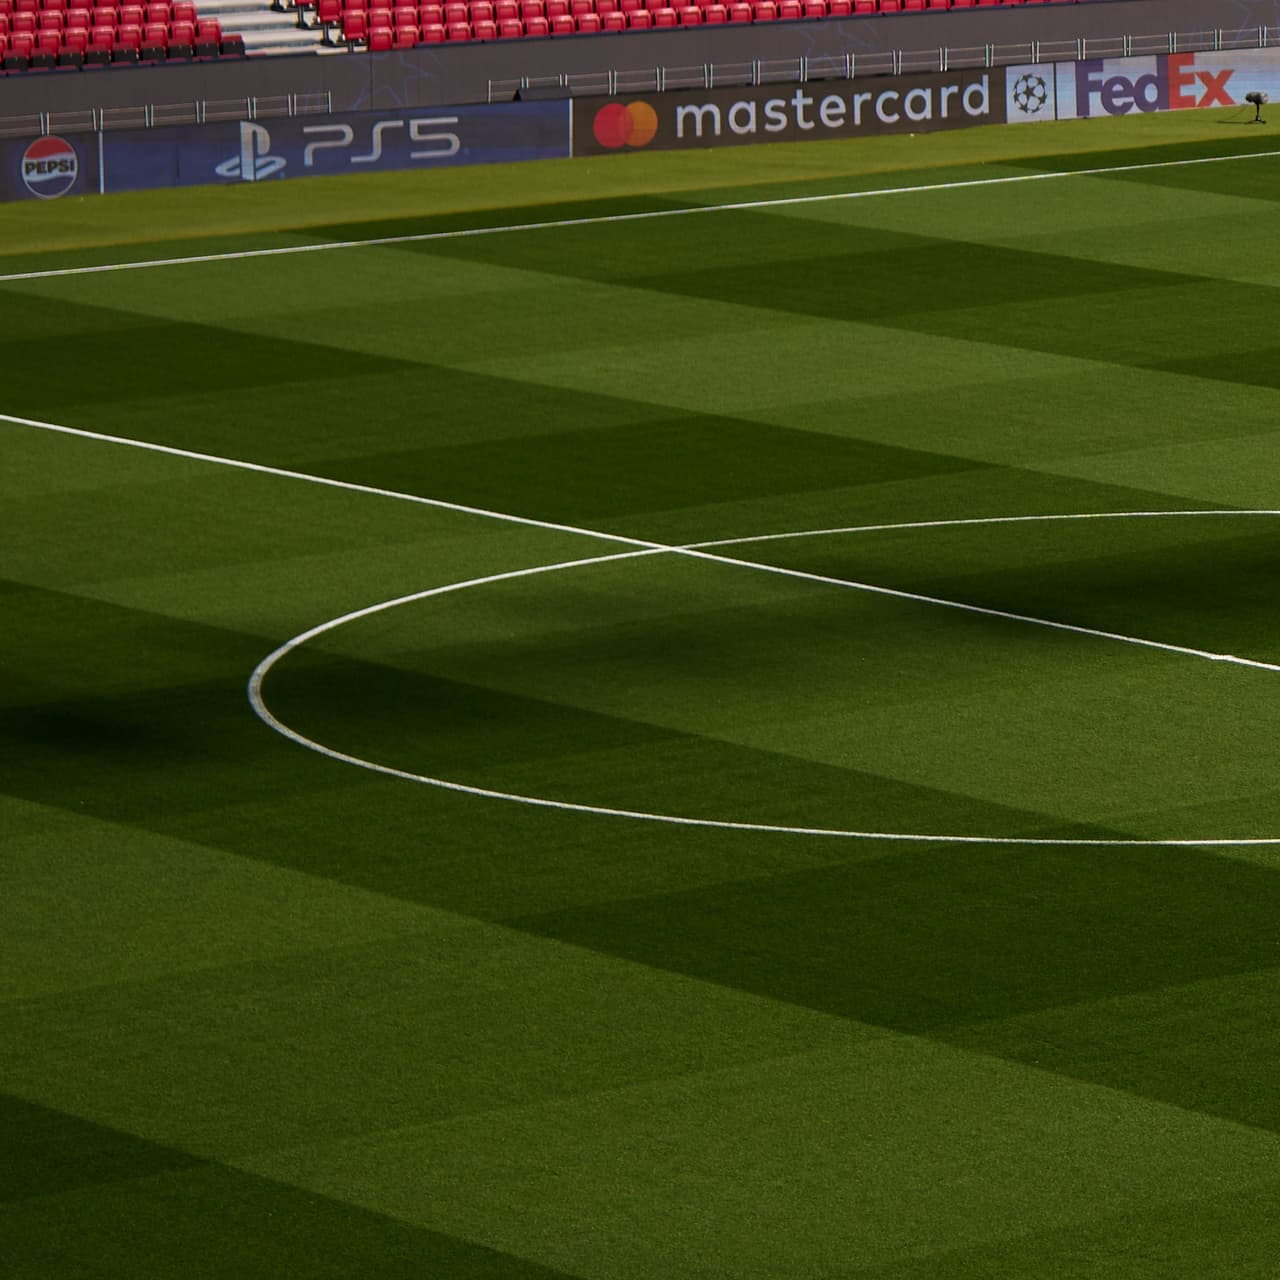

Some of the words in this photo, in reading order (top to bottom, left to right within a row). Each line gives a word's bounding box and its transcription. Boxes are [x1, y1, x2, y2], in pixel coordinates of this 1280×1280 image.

[676, 75, 990, 138] mastercard
[1075, 52, 1235, 118] FedEx
[25, 159, 75, 176] PEPSI
[303, 117, 460, 166] PS5
